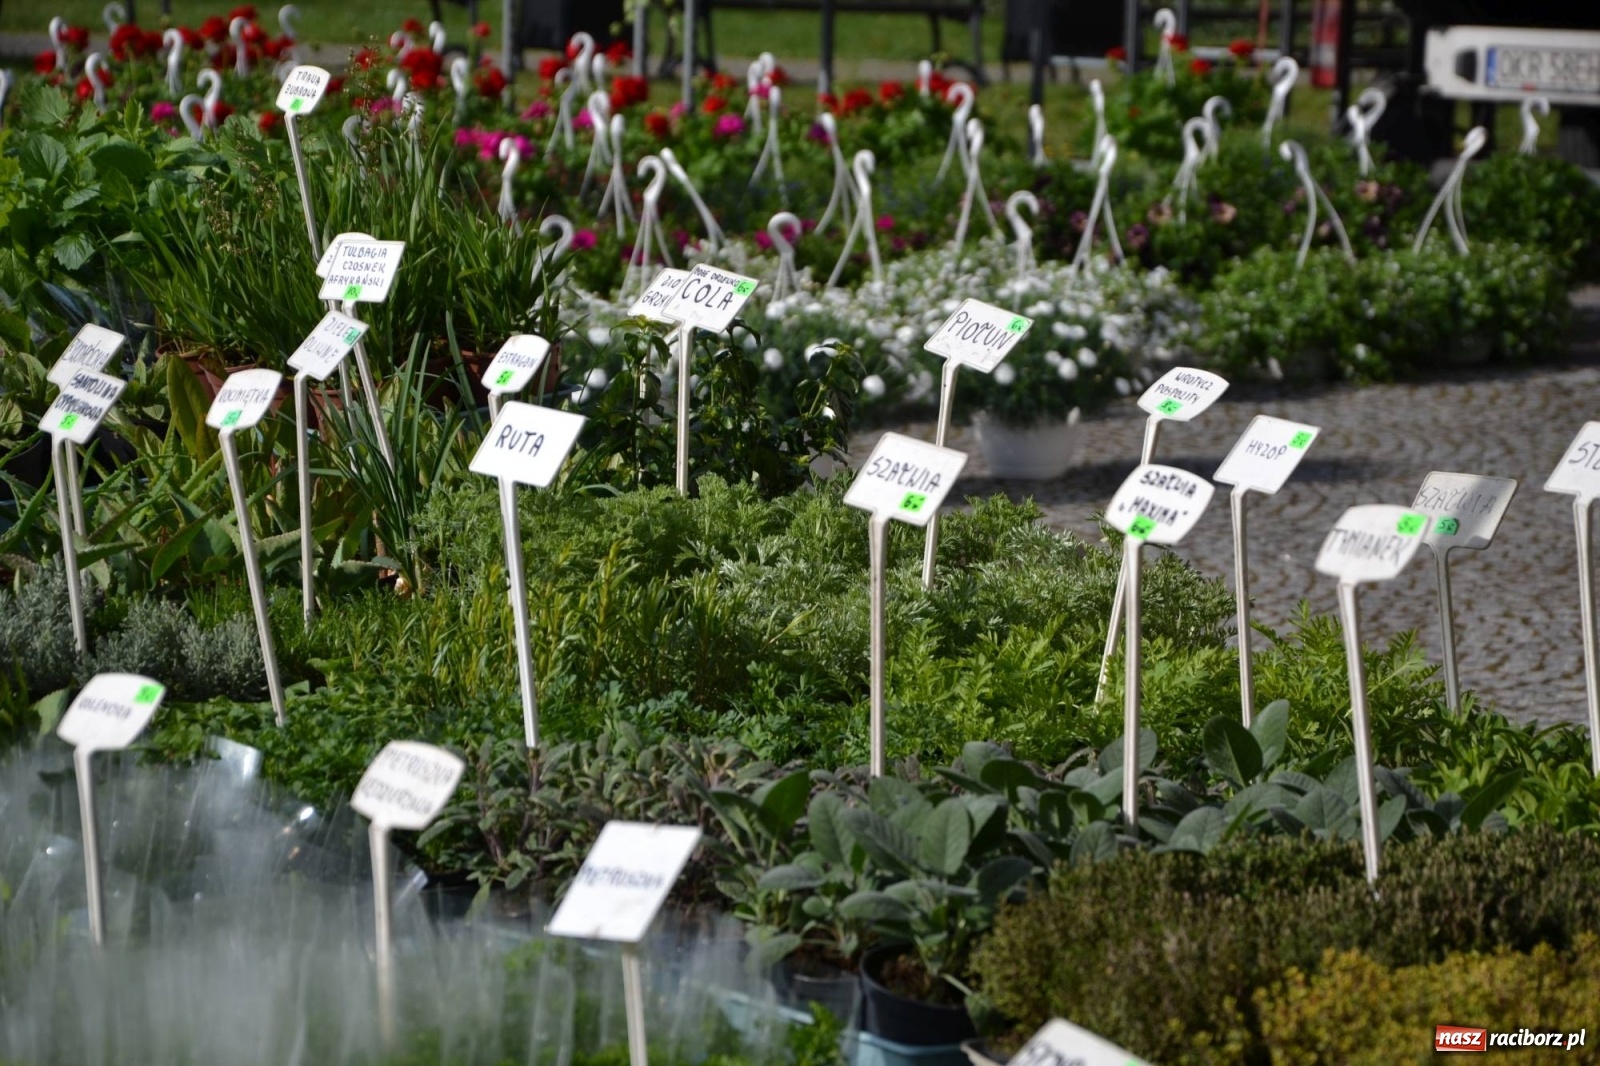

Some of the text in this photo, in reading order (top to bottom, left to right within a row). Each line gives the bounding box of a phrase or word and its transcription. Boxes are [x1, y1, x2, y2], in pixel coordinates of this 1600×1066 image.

[343, 245, 388, 259] TULBAGIA
[342, 260, 386, 274] CZOSNEK
[327, 274, 384, 288] AFRYKAŃSKI
[661, 275, 685, 289] ZIO
[680, 278, 734, 312] COLA
[497, 350, 538, 369] ESTRAGON
[1174, 371, 1214, 391] WROTYCZ
[1154, 382, 1200, 405] POSPOLITY
[494, 423, 545, 458] RUTA
[1244, 439, 1288, 461] HYZOP
[866, 455, 942, 493] SZAŁWIA
